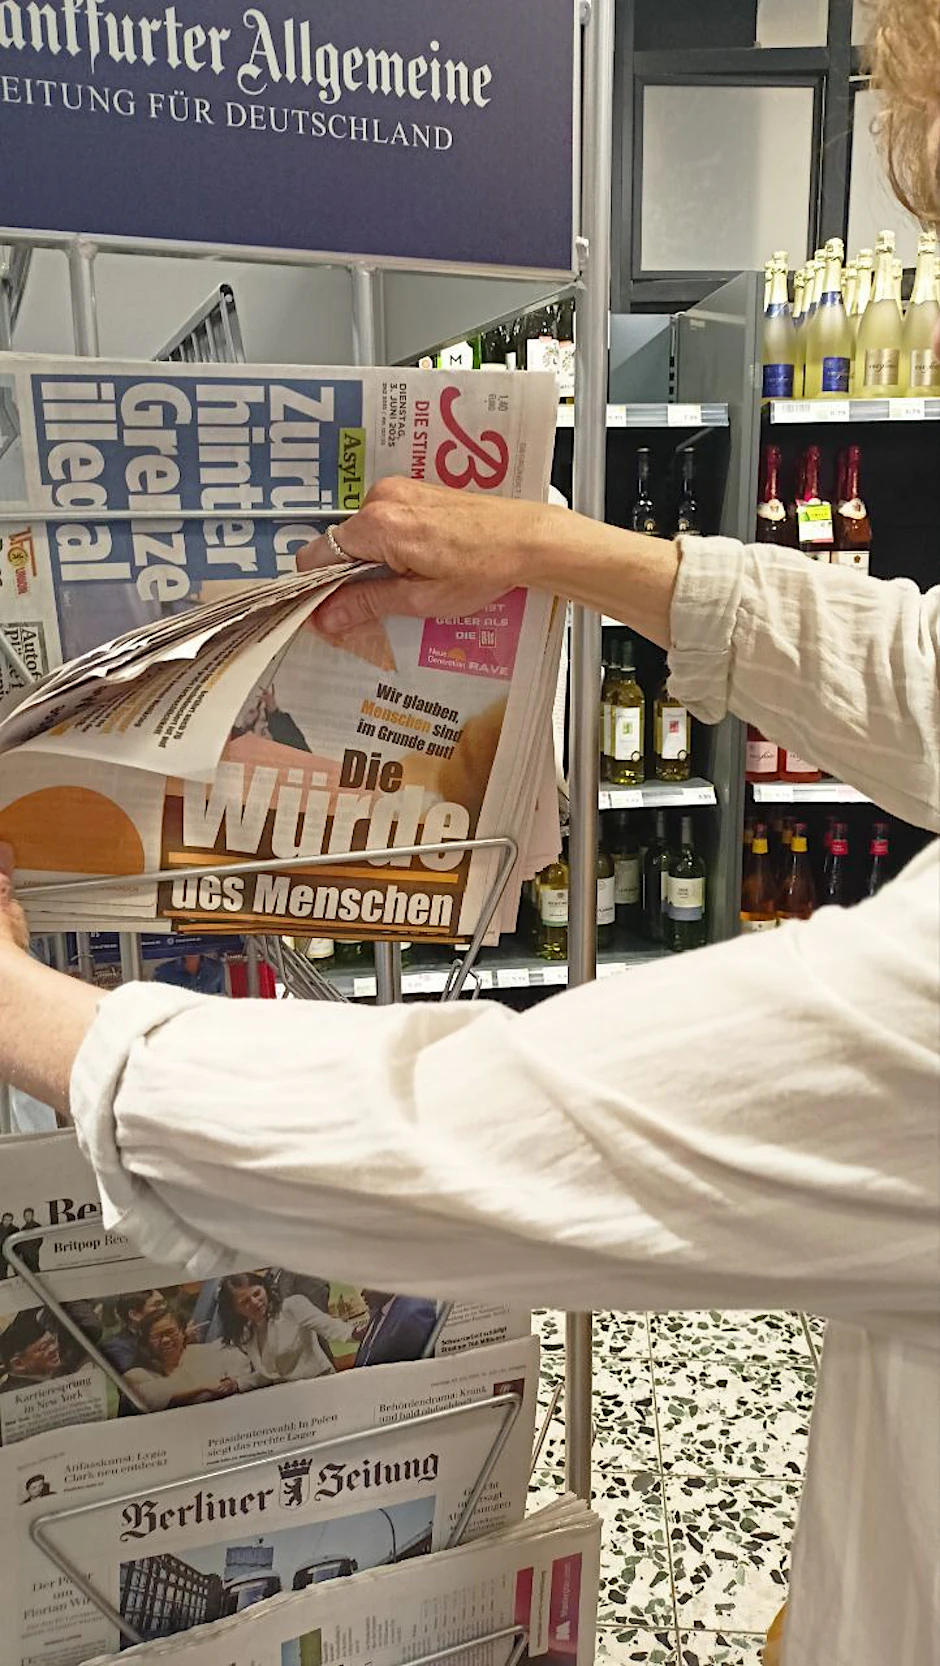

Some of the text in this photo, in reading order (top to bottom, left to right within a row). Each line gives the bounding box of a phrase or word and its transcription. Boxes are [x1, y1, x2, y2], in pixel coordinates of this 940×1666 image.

[0, 0, 493, 109] ankfurter Allgemeine
[1, 75, 454, 151] EITUNG FÜR DEUTSCHLAND
[388, 383, 398, 448] 3. JUNI 2025
[397, 383, 407, 439] DIENSTAG,
[414, 400, 430, 427] DIE
[41, 381, 132, 581] illegal
[120, 382, 192, 601] Grenze
[196, 384, 267, 572] hinter
[456, 631, 477, 640] DIE
[468, 661, 510, 676] RAVE
[360, 699, 463, 743] Menschen sind
[376, 683, 459, 724] Wir glauben,
[356, 718, 455, 760] im Grunde gut!
[339, 748, 403, 793] Die
[182, 760, 471, 871] Würde
[171, 873, 455, 928] des Menschen
[54, 1238, 100, 1253] Britpop
[37, 1399, 58, 1409] New
[60, 1390, 83, 1402] York
[298, 1420, 309, 1429] In
[310, 1414, 338, 1427] Polen
[233, 1441, 251, 1452] das
[287, 1429, 317, 1442] Lager
[119, 1452, 440, 1542] Berliner Zeitung
[33, 1580, 56, 1592] Der
